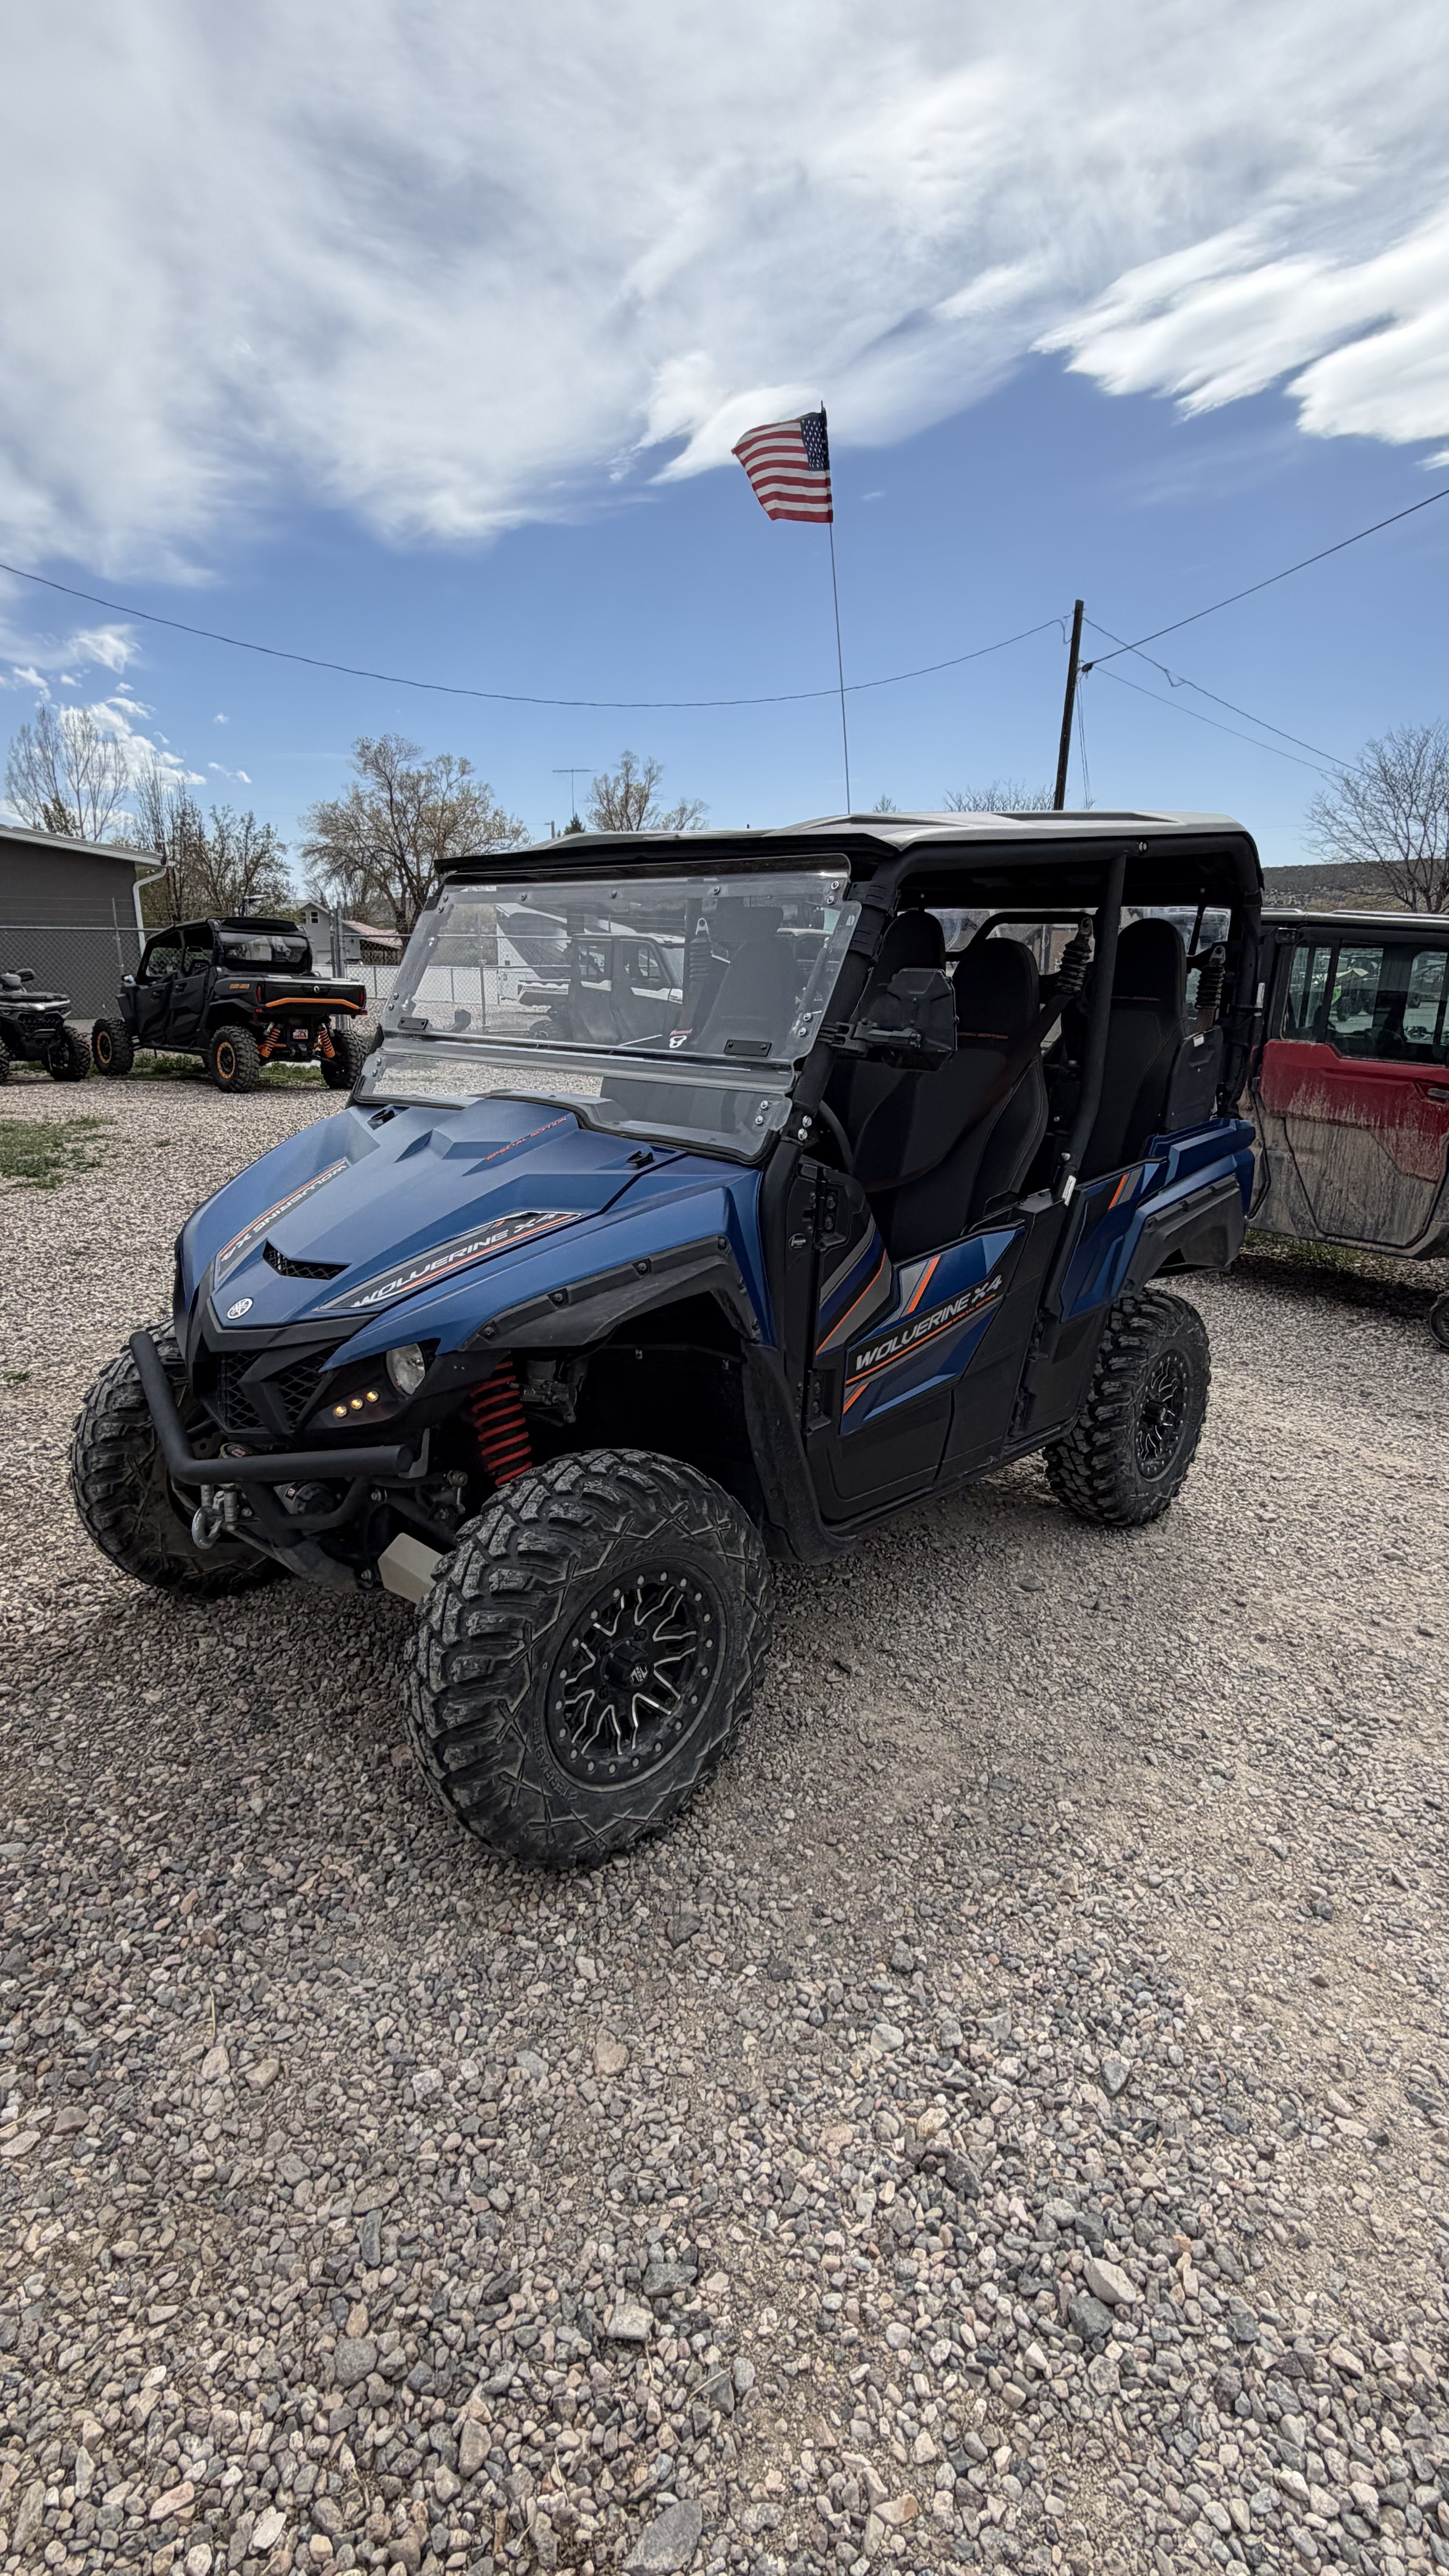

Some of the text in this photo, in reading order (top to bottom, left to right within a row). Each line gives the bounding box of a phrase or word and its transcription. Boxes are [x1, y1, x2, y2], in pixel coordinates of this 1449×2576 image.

[221, 1233, 252, 1262] X4
[351, 1213, 558, 1308] WOLVERINE X4
[856, 1292, 971, 1371] WOLVERINE
[971, 1274, 1003, 1303] X4
